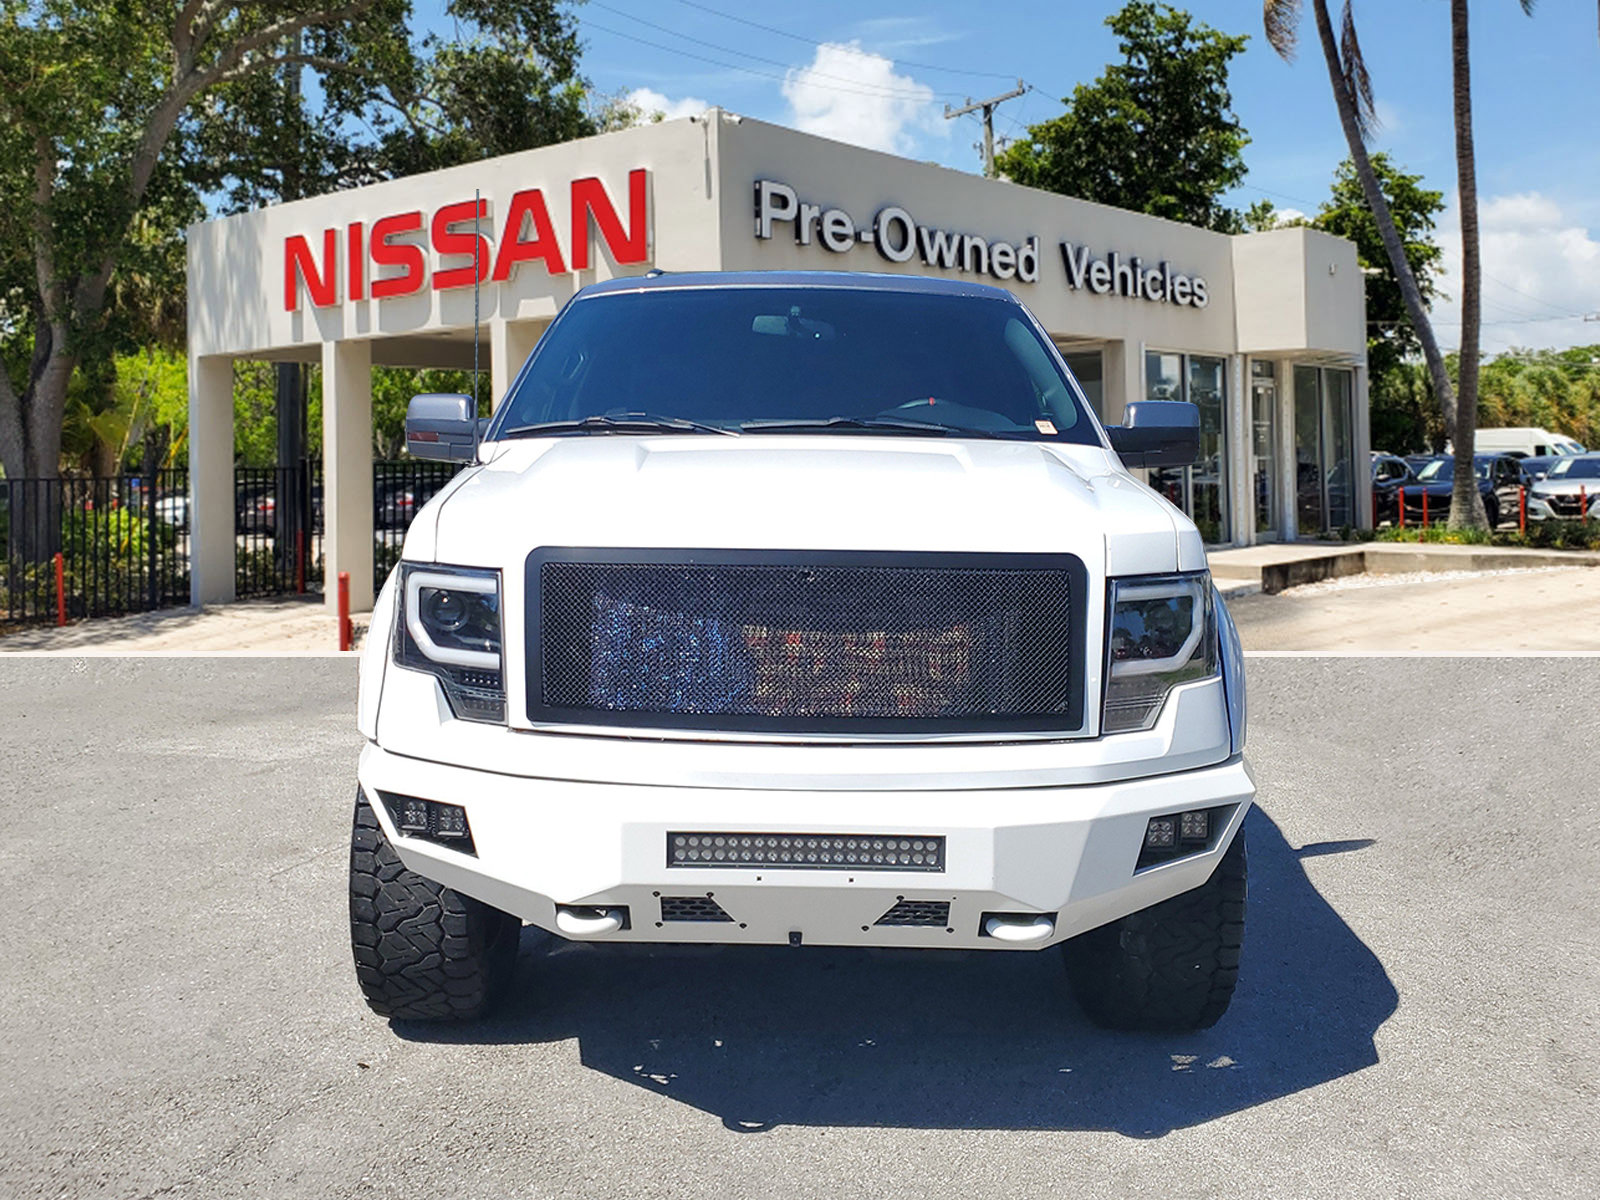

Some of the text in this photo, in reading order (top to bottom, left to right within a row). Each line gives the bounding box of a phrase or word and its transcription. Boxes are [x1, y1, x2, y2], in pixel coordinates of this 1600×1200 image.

[285, 168, 646, 311] NISSAN
[754, 180, 1209, 308] Pre-Owned Vehicles
